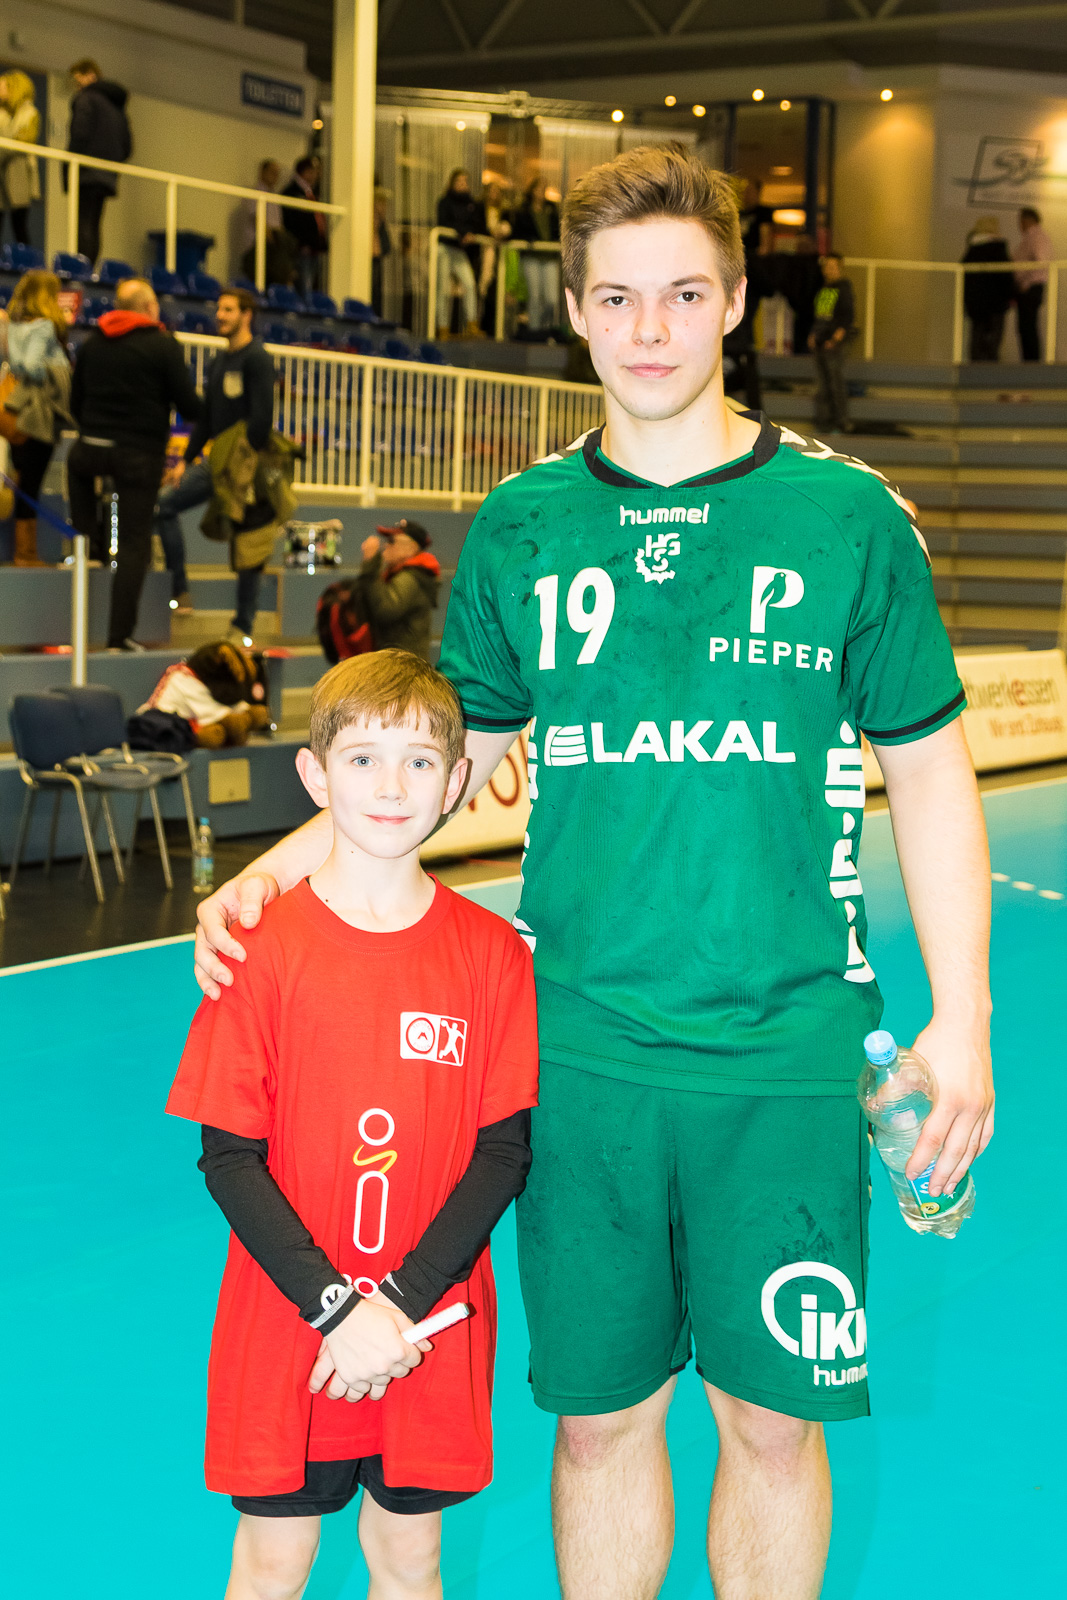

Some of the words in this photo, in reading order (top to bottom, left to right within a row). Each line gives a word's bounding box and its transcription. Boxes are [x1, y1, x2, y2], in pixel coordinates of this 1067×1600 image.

[619, 502, 710, 527] hummel
[534, 567, 615, 670] 19
[709, 637, 834, 672] PIEPER
[591, 720, 796, 763] LAKAL
